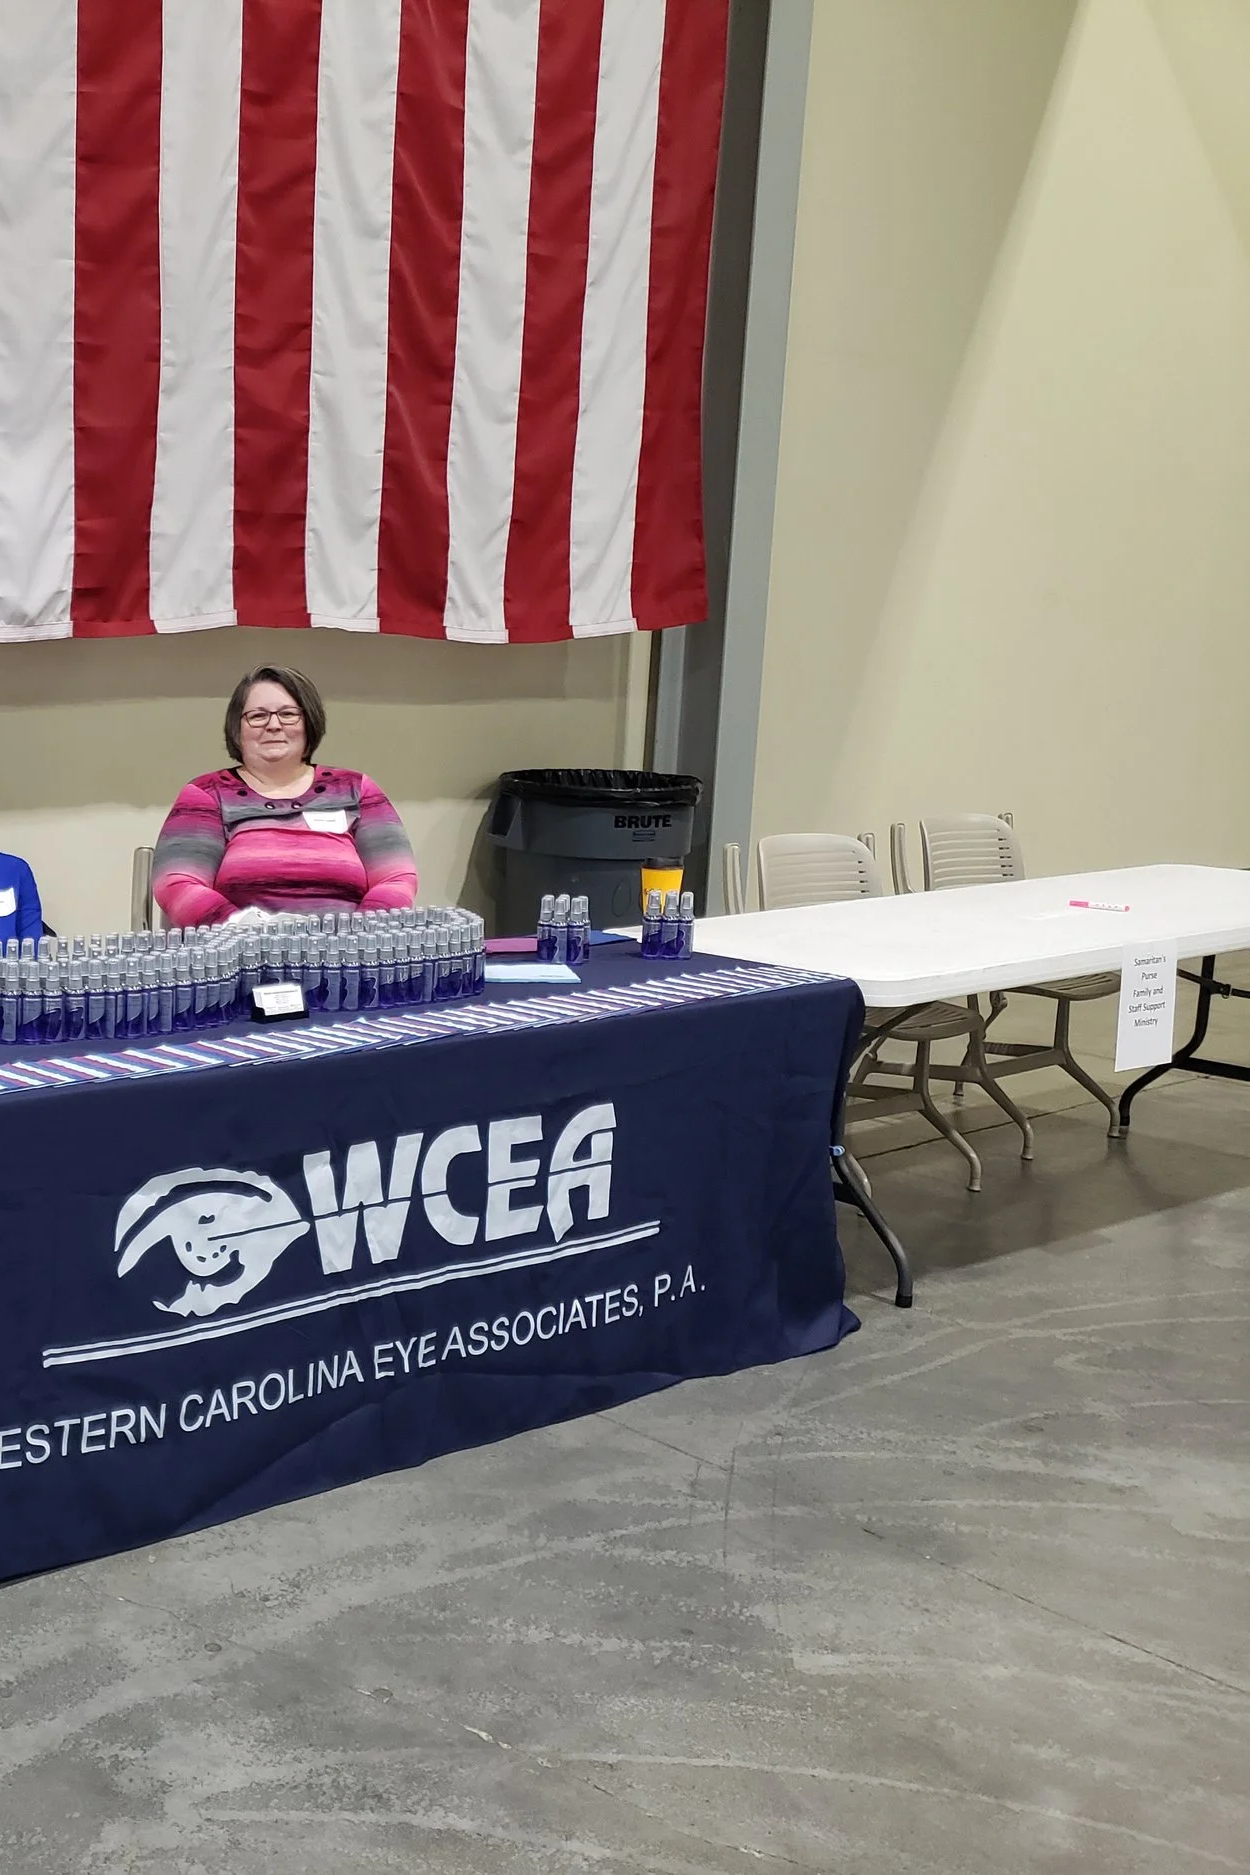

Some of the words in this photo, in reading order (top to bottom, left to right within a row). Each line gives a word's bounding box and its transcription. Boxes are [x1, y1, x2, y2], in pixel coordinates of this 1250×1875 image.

[614, 815, 672, 829] BRUTE
[1134, 956, 1166, 967] Samaritan's
[1141, 972, 1158, 981] Purse
[1133, 988, 1151, 998] Family
[1153, 987, 1163, 995] and
[1128, 1003, 1142, 1013] Staff
[1143, 1001, 1166, 1012] Support
[1134, 1017, 1158, 1027] Ministry
[303, 1102, 617, 1275] WCEA
[179, 1350, 364, 1432] CAROLINA
[372, 1337, 436, 1378] EYE
[441, 1287, 645, 1359] ASSOCIATES,
[653, 1265, 707, 1306] P.A.
